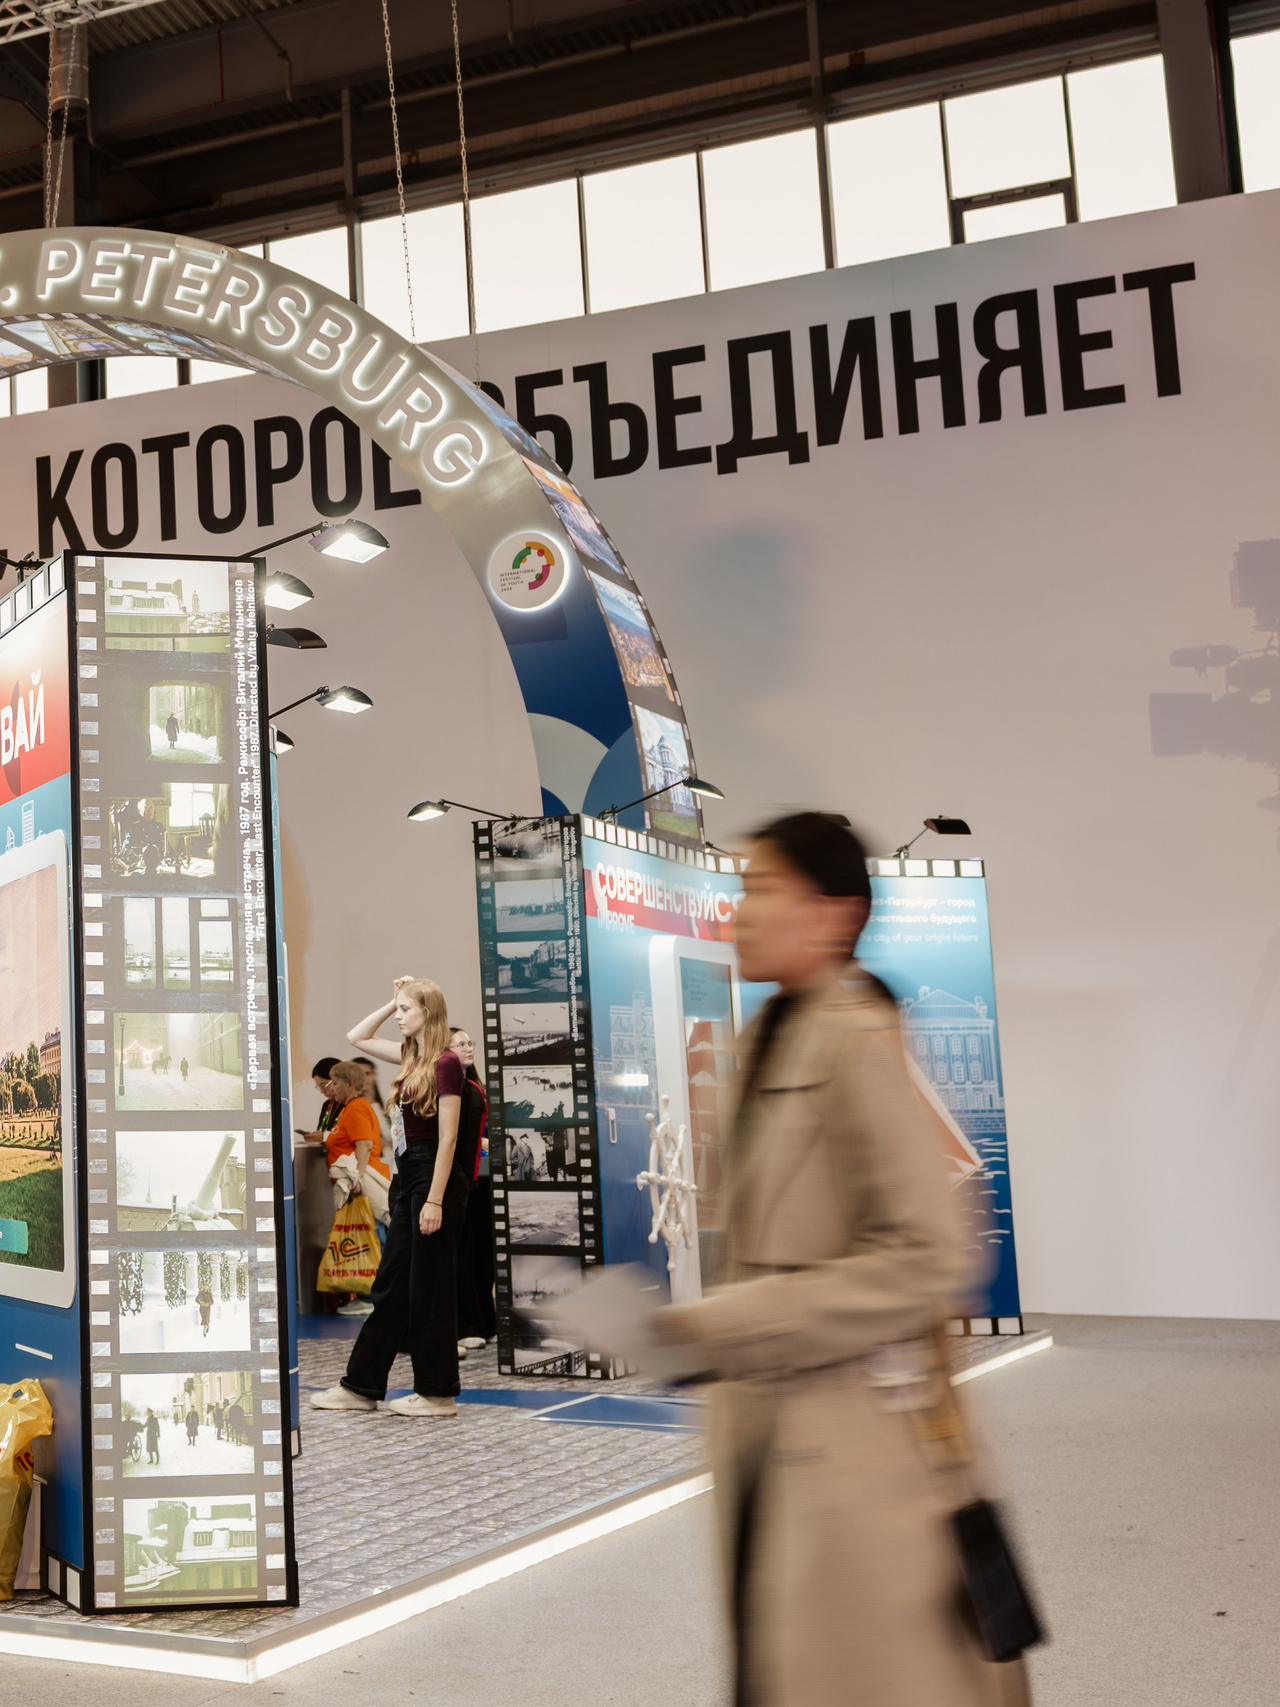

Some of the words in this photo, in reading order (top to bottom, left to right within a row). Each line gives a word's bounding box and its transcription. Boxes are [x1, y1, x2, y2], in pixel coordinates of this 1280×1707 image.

[35, 240, 490, 491] PETERSBURG
[233, 579, 244, 649] Мельников
[246, 580, 257, 629] Melnikov
[247, 631, 260, 662] Vitaly
[234, 652, 247, 705] Виталий
[248, 663, 260, 678] by
[249, 679, 260, 726] Directed
[236, 707, 250, 775] Режиссёр:
[249, 730, 261, 757] 1987.
[239, 776, 252, 804] год.
[250, 760, 262, 820] Encounter"
[239, 807, 251, 835] 1987
[252, 822, 263, 849] Last
[252, 850, 265, 908] Encounter,
[564, 861, 572, 897] Владимир
[566, 898, 574, 935] Режиссёр:
[572, 891, 580, 918] Directed
[869, 914, 928, 924] счастливого
[930, 913, 977, 925] будущего
[947, 898, 976, 908] город
[244, 900, 257, 972] последняя
[597, 909, 635, 935] IMPROVE
[873, 933, 890, 944] city
[892, 933, 902, 942] of
[903, 935, 923, 944] your
[925, 933, 951, 944] bright
[952, 933, 979, 942] future
[245, 974, 258, 1032] встреча,
[246, 1033, 259, 1091] «Первая
